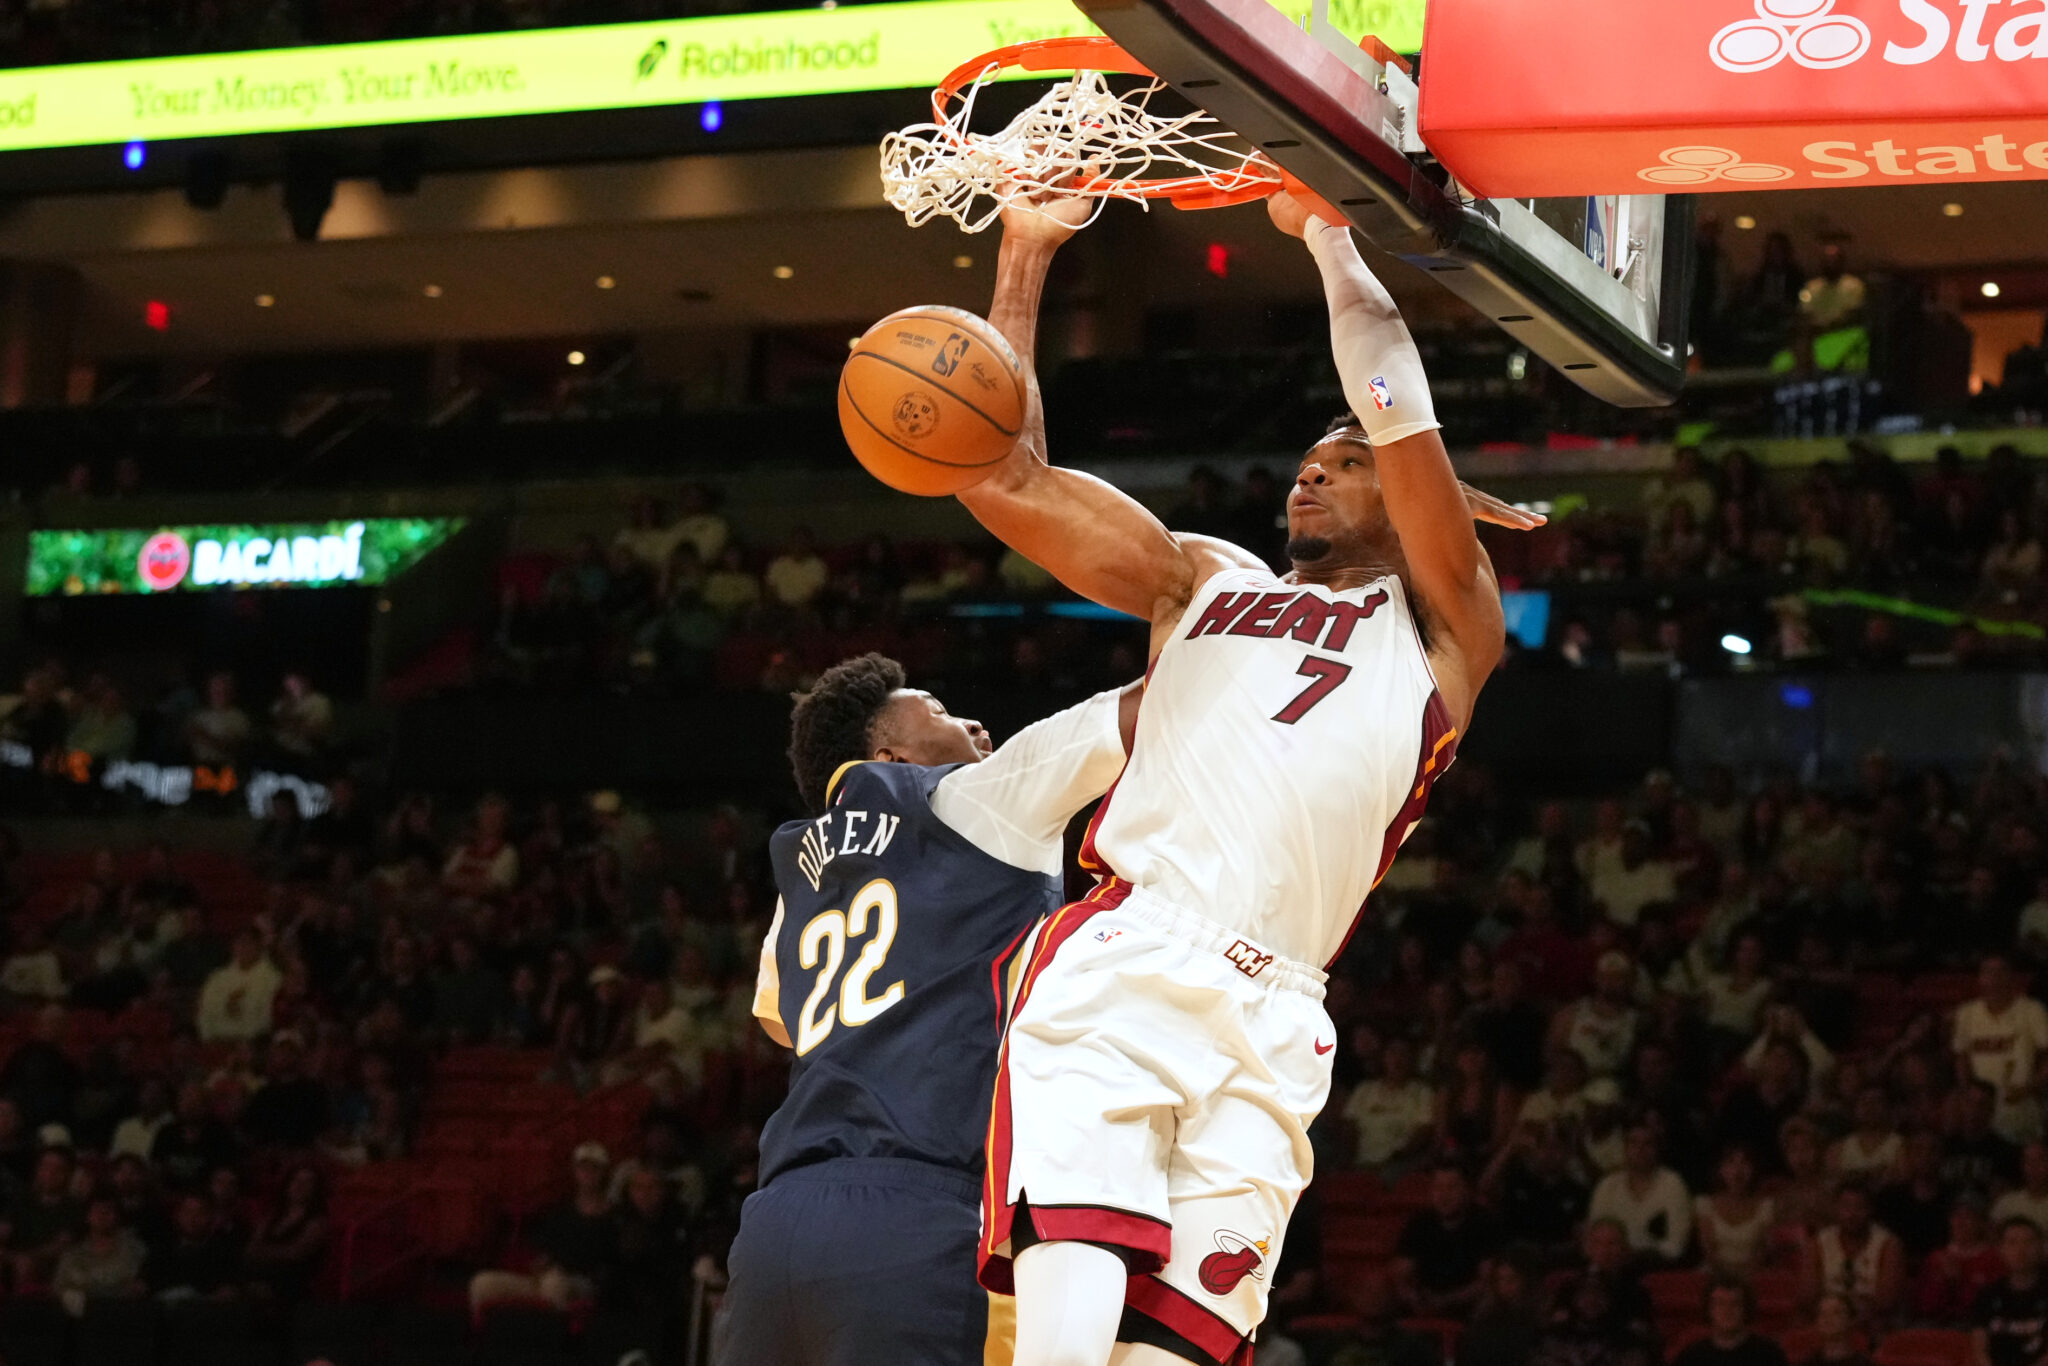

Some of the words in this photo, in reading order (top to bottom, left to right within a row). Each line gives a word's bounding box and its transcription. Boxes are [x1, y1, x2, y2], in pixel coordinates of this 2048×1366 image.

[679, 31, 880, 78] Robinhood
[130, 82, 207, 119] Your
[340, 66, 420, 104] Your
[424, 60, 527, 98] Move.
[192, 521, 365, 585] BACARDÍ
[1184, 587, 1389, 653] HEAT
[1270, 654, 1353, 725] 7
[798, 810, 900, 892] QUEEN
[796, 878, 905, 1057] 22
